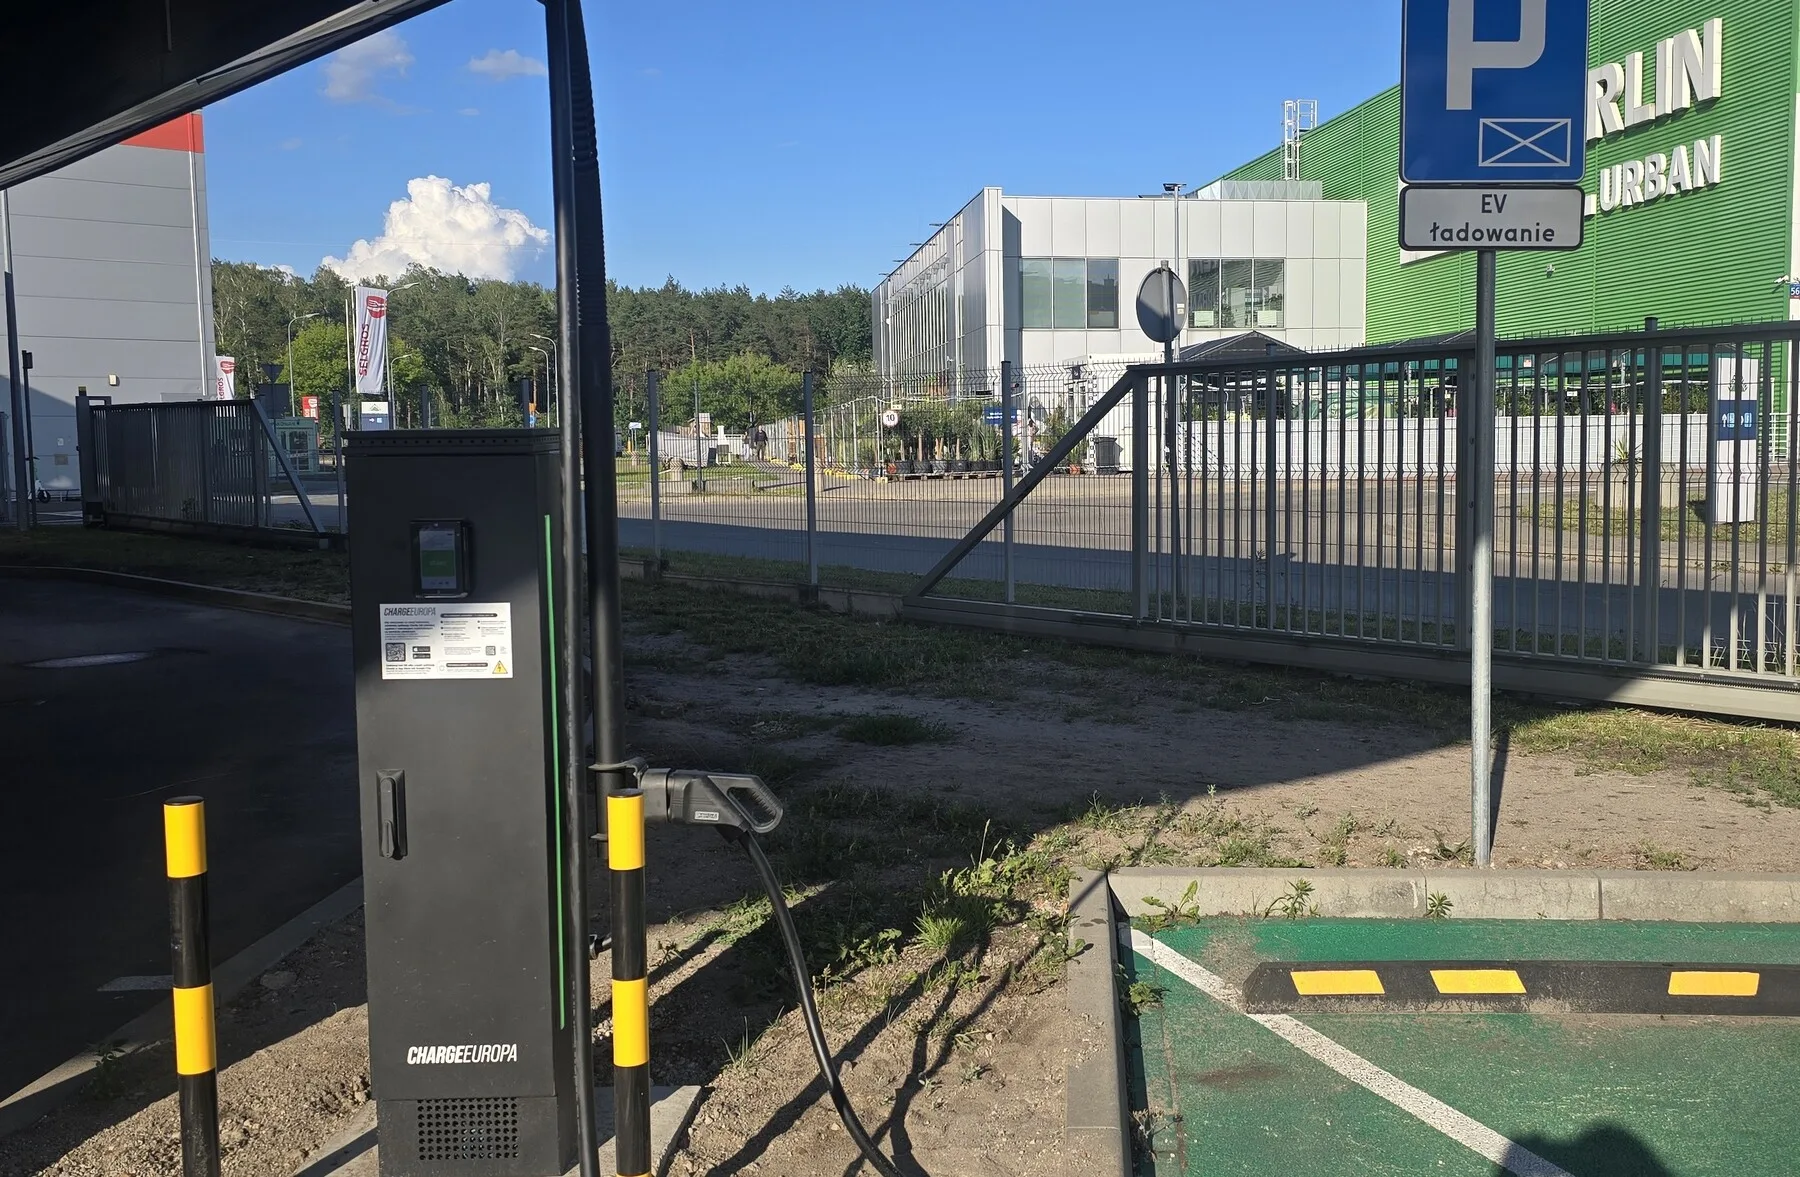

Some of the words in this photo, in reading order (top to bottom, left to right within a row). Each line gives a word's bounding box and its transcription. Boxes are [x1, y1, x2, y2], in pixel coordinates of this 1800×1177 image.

[1446, 0, 1547, 110] P
[1481, 194, 1507, 213] EV
[1430, 222, 1555, 242] ładowanie
[359, 323, 370, 376] SELGROS
[383, 607, 436, 616] CHARGEEUROPA
[407, 1044, 517, 1065] CHARGEEUROPA
